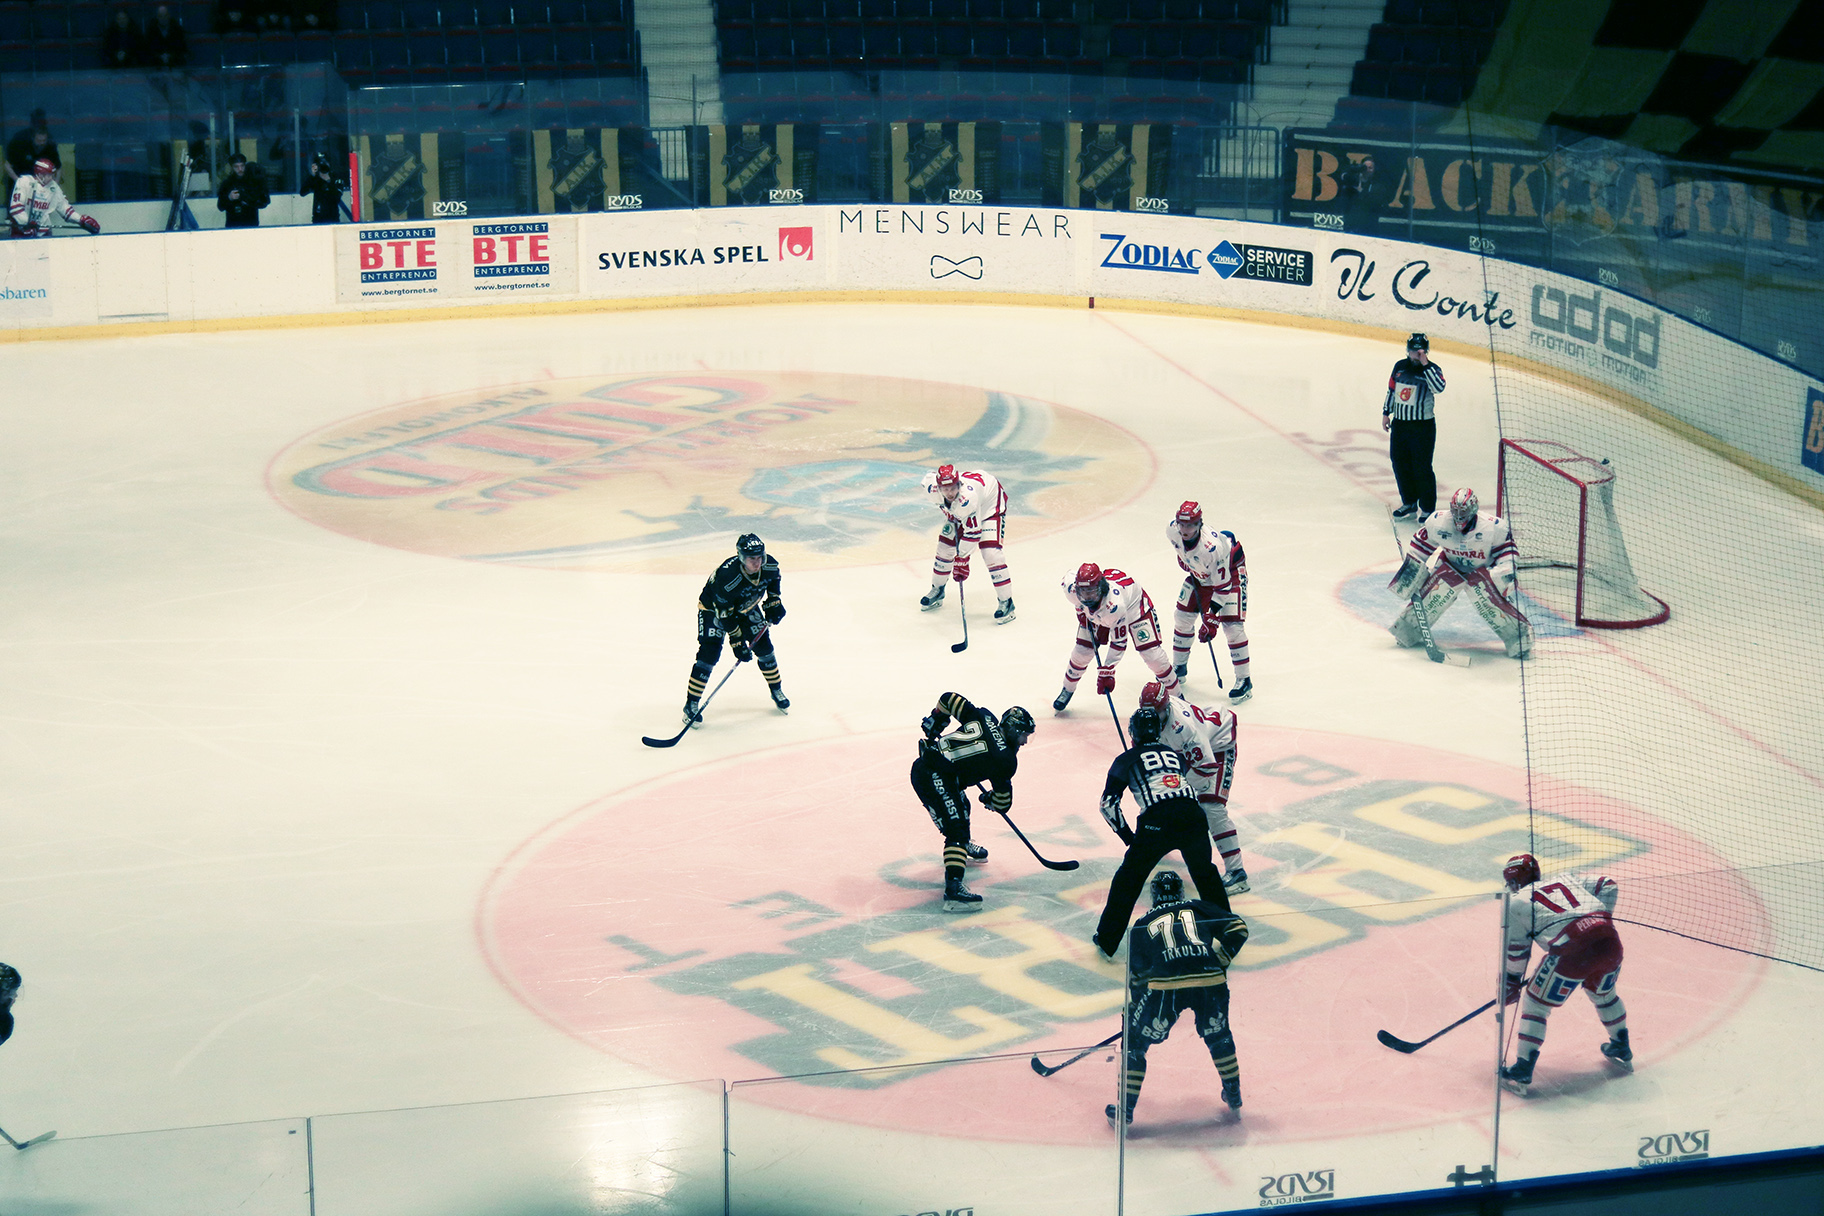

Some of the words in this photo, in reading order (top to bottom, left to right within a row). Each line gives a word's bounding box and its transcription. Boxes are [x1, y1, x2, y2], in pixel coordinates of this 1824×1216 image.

[1291, 148, 1539, 217] BACK
[608, 194, 643, 206] RYDS
[769, 189, 803, 201] RYDS
[949, 189, 983, 201] RYDS
[433, 201, 467, 213] RYDS
[1136, 197, 1168, 209] RYDS
[840, 209, 1072, 239] MENSWEAR
[1314, 213, 1344, 225] RYDS
[360, 228, 434, 239] BERGTORNET
[474, 224, 547, 234] BERGTORNET
[360, 240, 437, 270] BTE
[473, 235, 549, 264] BTE
[1100, 233, 1202, 274] ZODIAC
[598, 248, 705, 270] SVENSKA
[713, 245, 769, 264] SPEL
[1246, 248, 1305, 267] SERVICE
[361, 271, 436, 281] ENTREPRENAD
[474, 265, 548, 275] ENTREPRENAD
[1246, 262, 1304, 282] CENTER
[361, 286, 438, 297] www.bergtornet.se
[474, 281, 550, 291] www.bergtornet.se
[1392, 260, 1516, 329] Conte
[965, 515, 978, 528] 41
[1217, 566, 1226, 580] 7
[1114, 625, 1126, 639] 18
[938, 720, 989, 763] 21
[1140, 750, 1181, 771] 86
[1532, 882, 1581, 914] 17
[1147, 909, 1207, 949] 71
[1162, 944, 1209, 962] TRKULJA
[1141, 1025, 1168, 1040] BST
